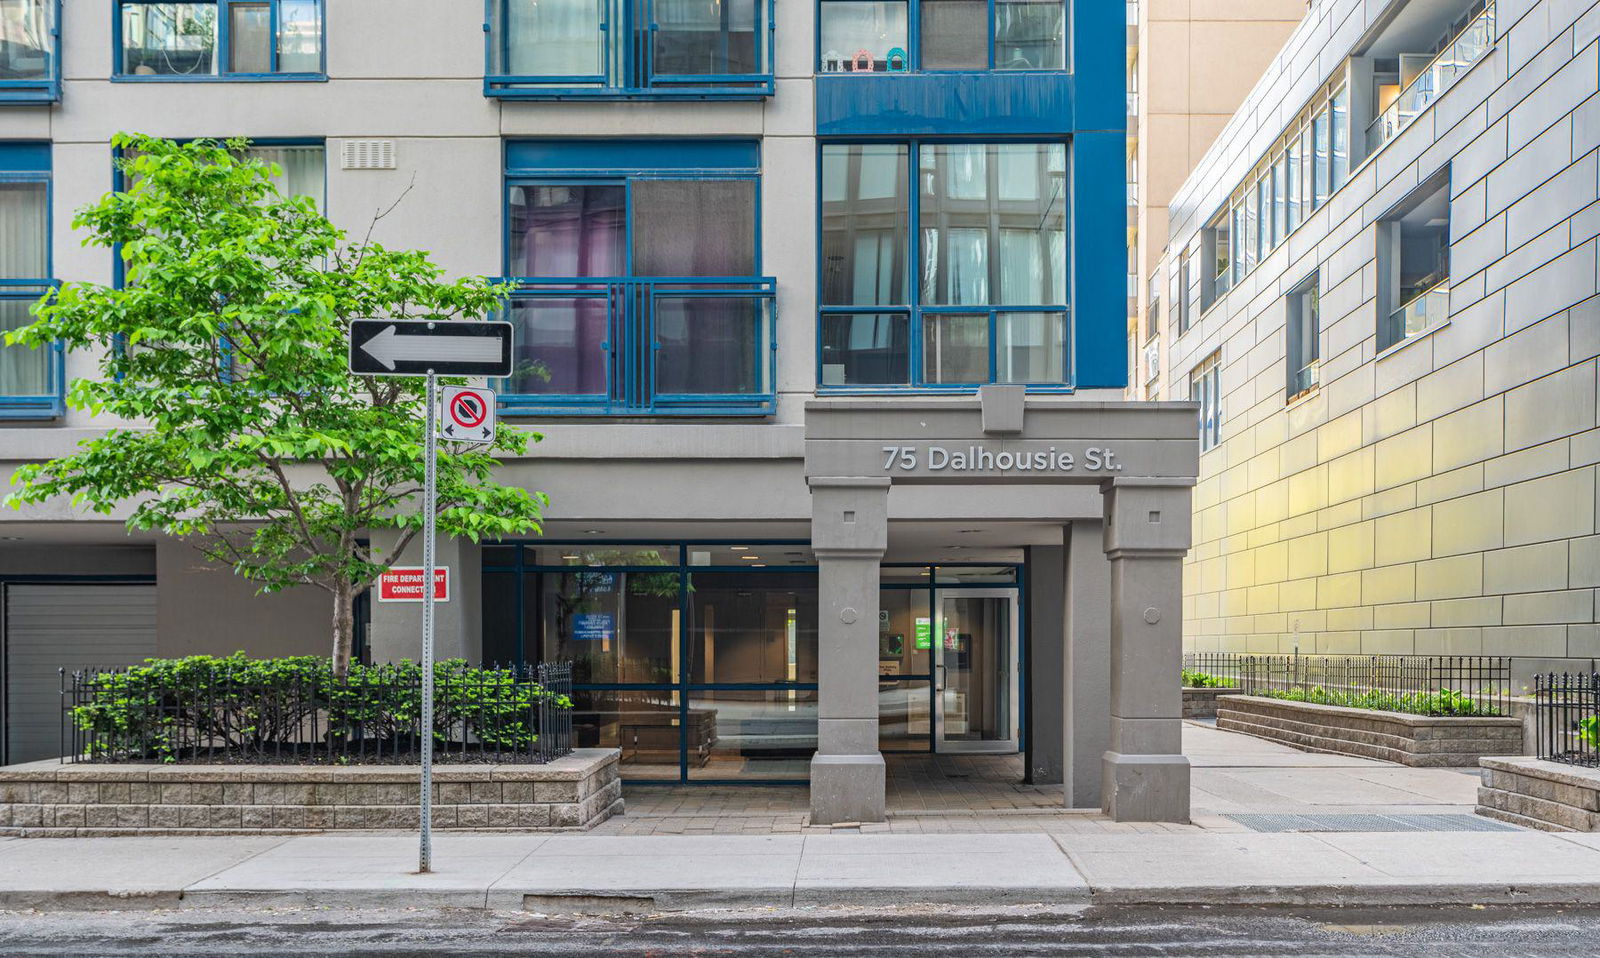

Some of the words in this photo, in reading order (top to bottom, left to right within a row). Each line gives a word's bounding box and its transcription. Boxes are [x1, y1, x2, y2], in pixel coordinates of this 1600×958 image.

[883, 447, 917, 470] 75
[928, 446, 1074, 471] Dalhousie
[1085, 447, 1122, 470] St.
[383, 575, 399, 583] FIRE
[400, 574, 445, 583] DEPARTNT
[392, 585, 436, 594] CONNECT
